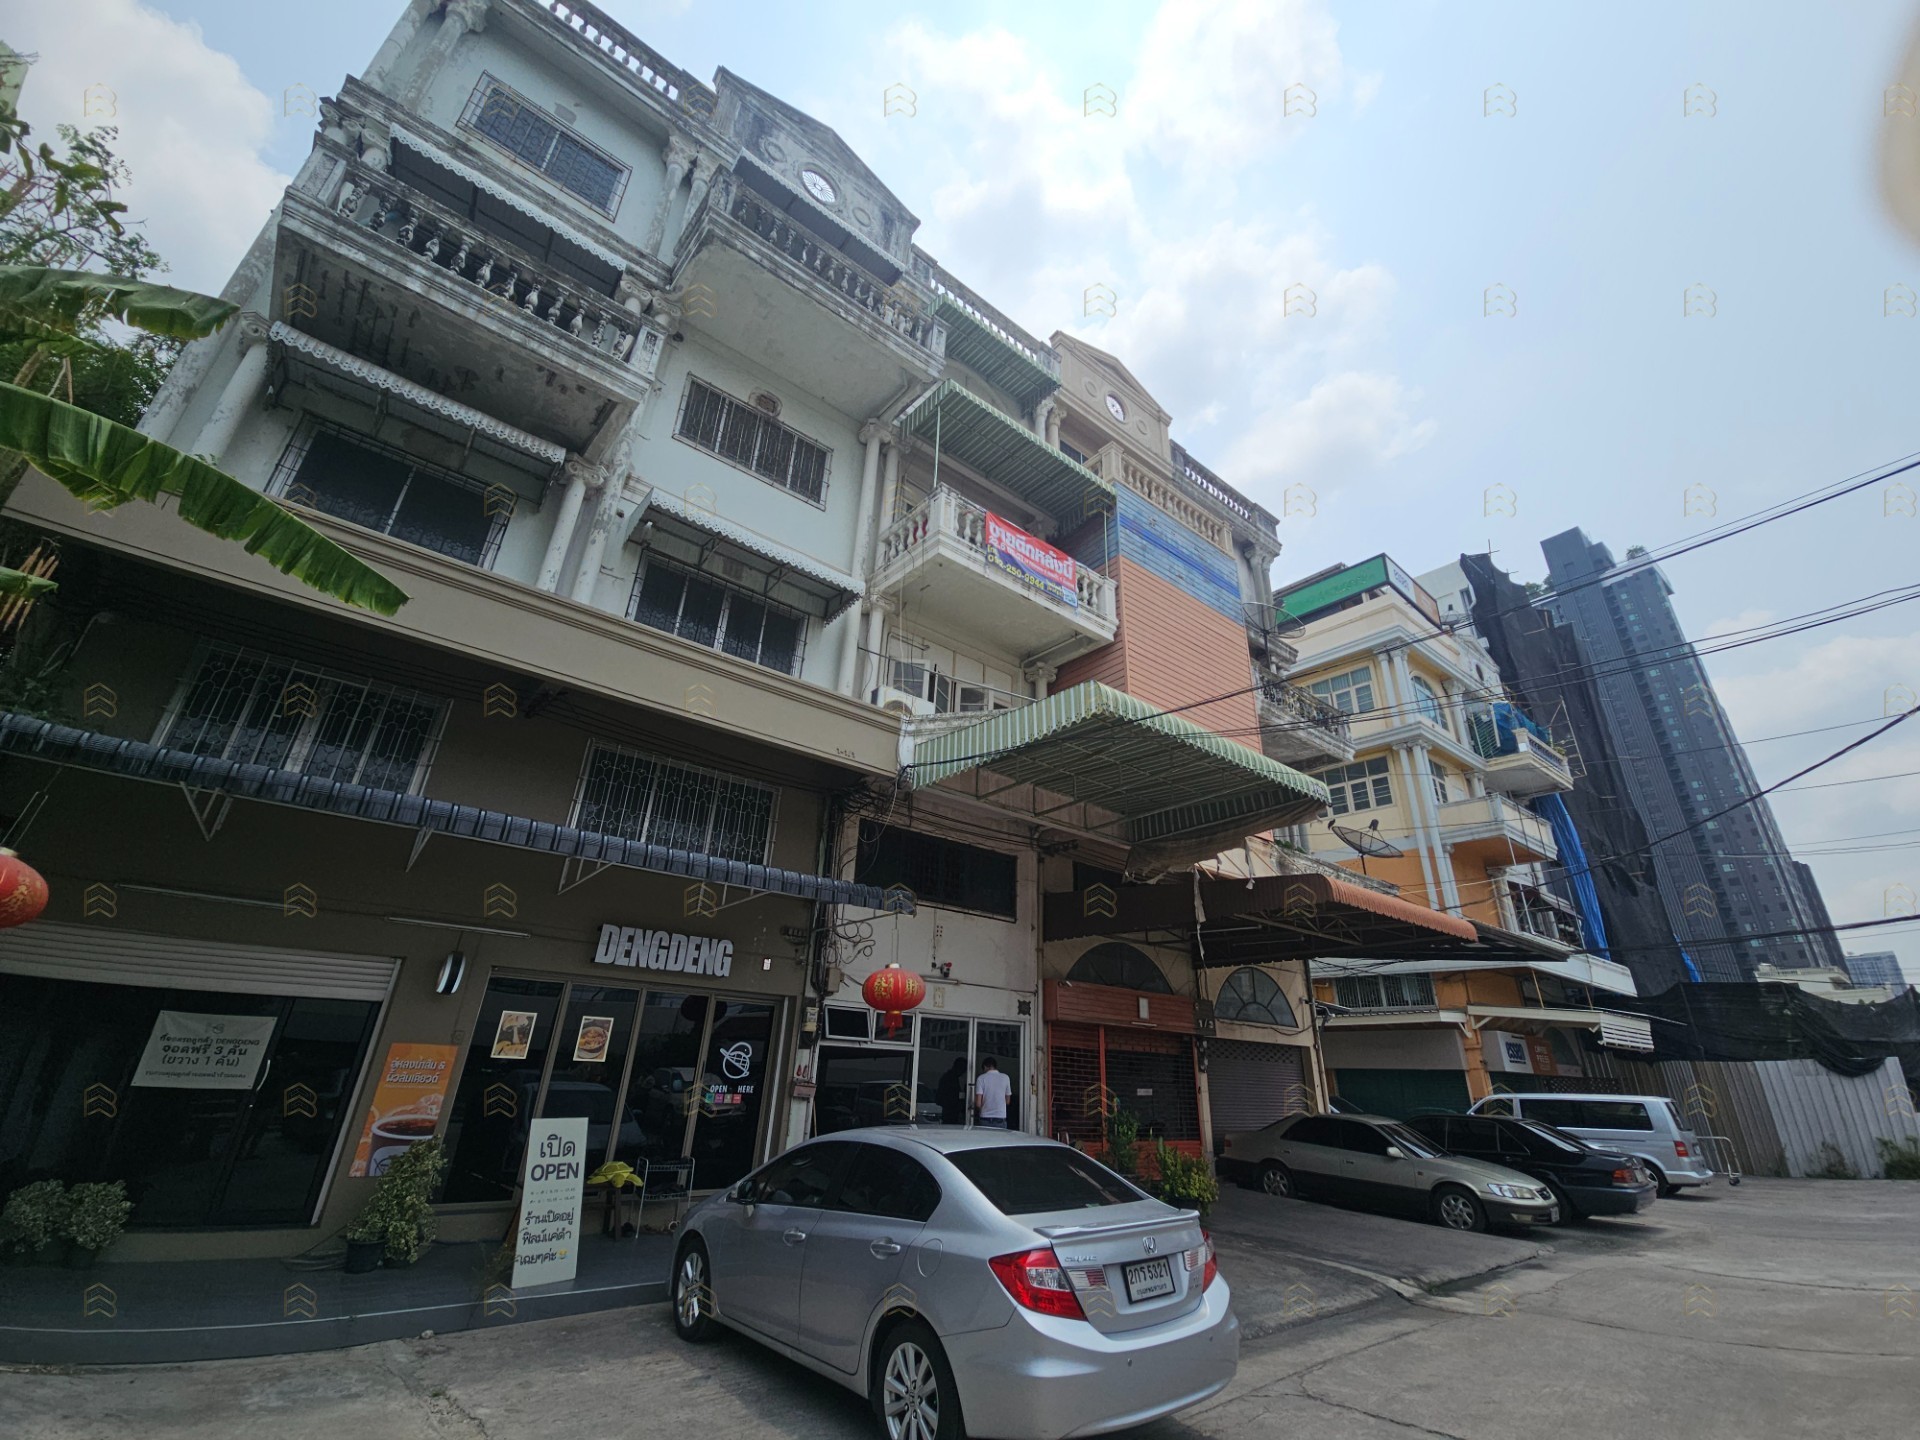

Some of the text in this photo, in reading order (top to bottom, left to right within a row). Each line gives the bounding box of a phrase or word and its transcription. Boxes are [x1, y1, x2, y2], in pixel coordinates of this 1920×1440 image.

[594, 923, 735, 977] DENGDENG
[162, 1043, 248, 1056] จอดฟรี 3 คัน
[215, 1038, 260, 1046] DENGDENG
[204, 1056, 211, 1065] 1
[215, 1055, 240, 1067] คัน)
[438, 1060, 446, 1070] &
[710, 1085, 754, 1094] OPEN HERE
[540, 1133, 576, 1158] เปิด
[530, 1162, 580, 1182] OPEN
[525, 1207, 574, 1225] ร้านเปิดอยู่
[1148, 1261, 1169, 1281] 5321
